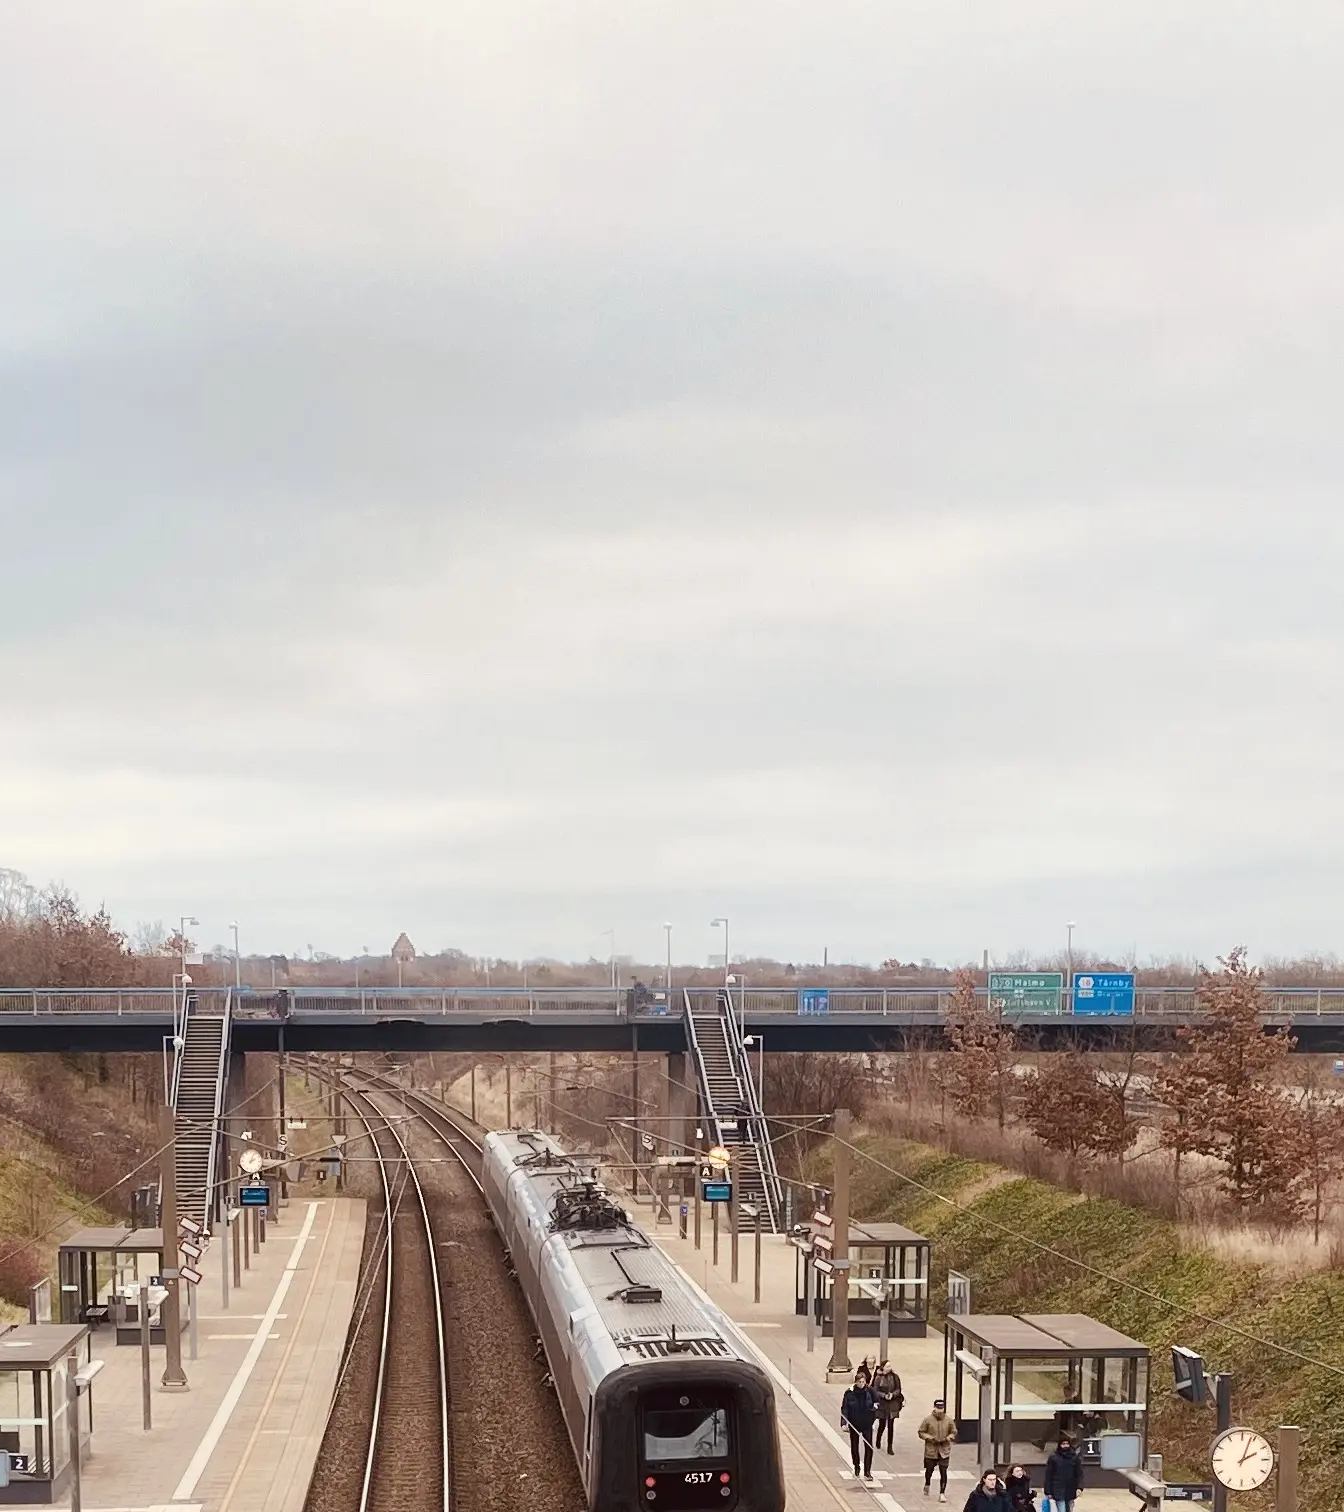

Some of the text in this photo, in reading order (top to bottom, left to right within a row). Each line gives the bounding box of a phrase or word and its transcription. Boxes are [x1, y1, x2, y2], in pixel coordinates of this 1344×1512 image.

[702, 1167, 711, 1176] A
[15, 1459, 25, 1470] 2
[684, 1472, 713, 1484] 4517
